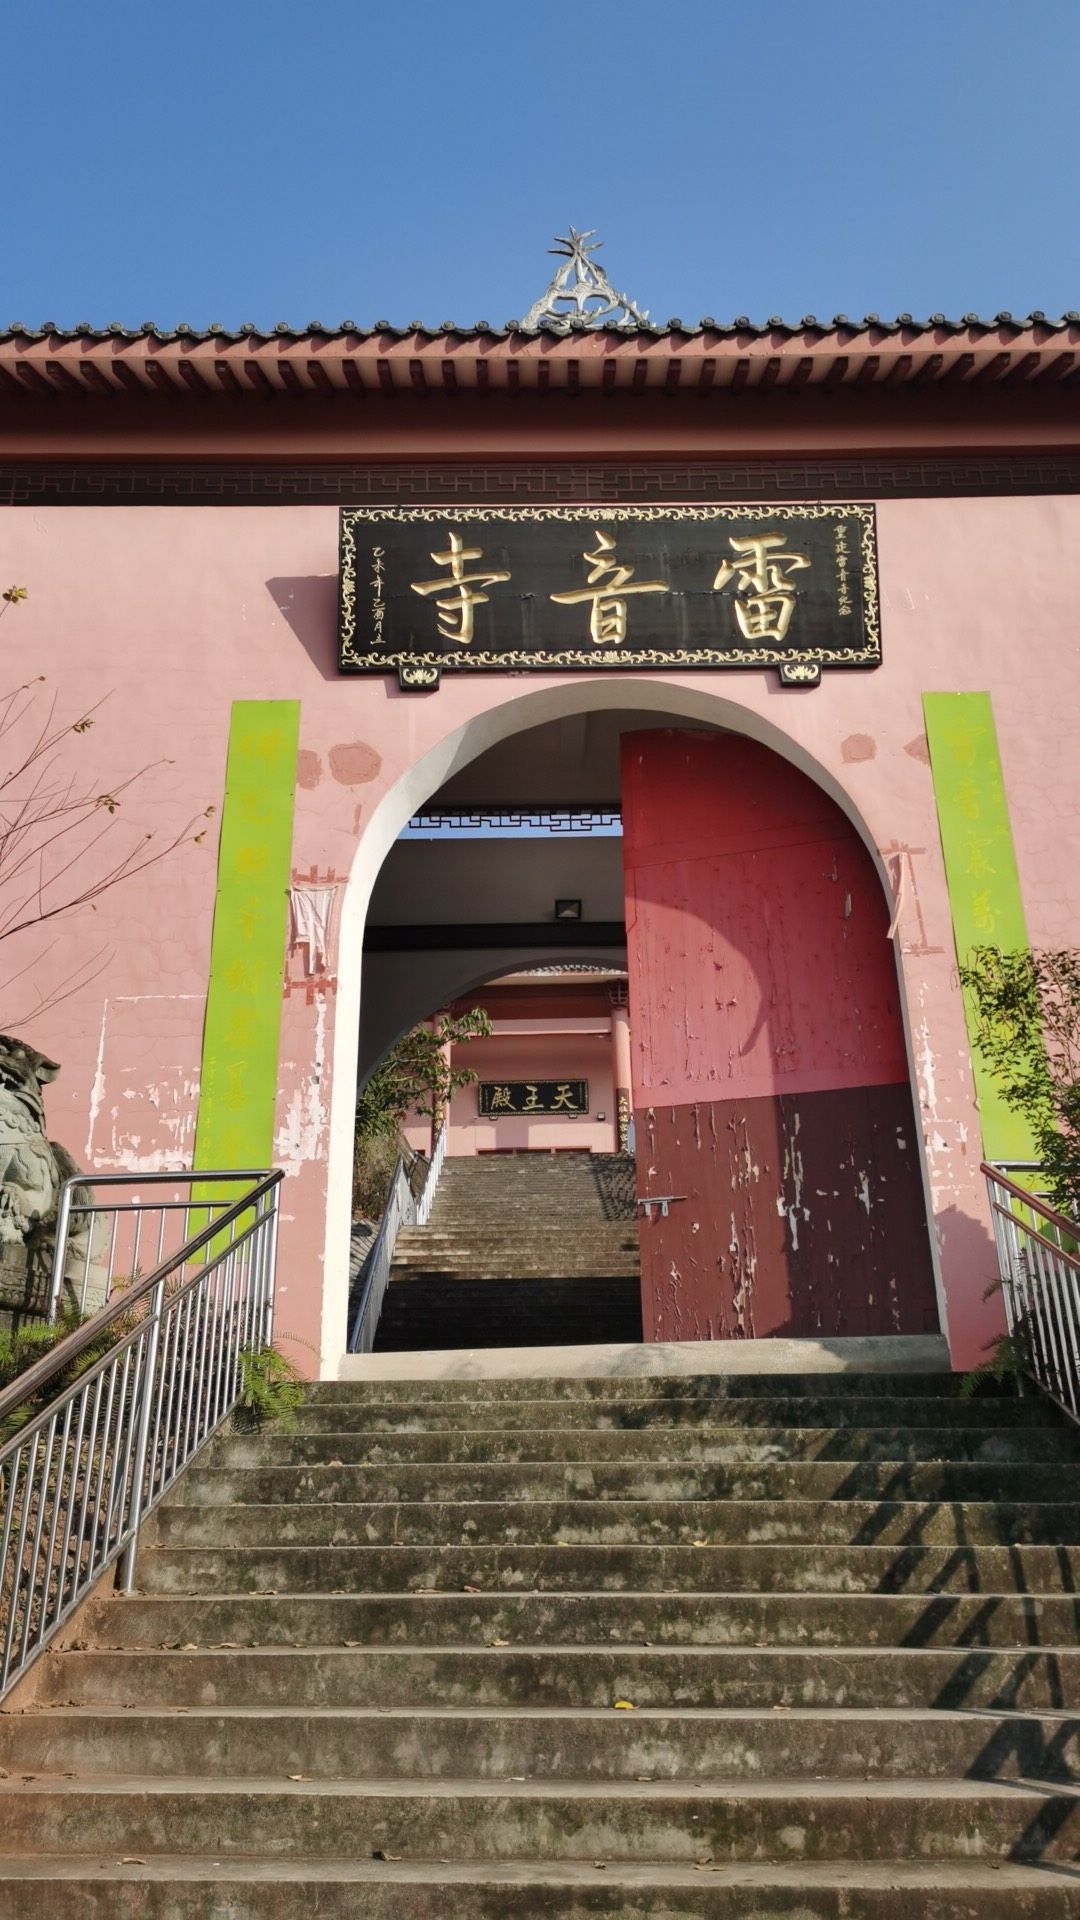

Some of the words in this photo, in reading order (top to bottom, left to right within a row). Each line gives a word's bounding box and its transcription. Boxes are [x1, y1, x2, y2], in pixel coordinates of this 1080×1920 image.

[410, 529, 812, 645] 雷音寺
[490, 1084, 579, 1111] 天王殿
